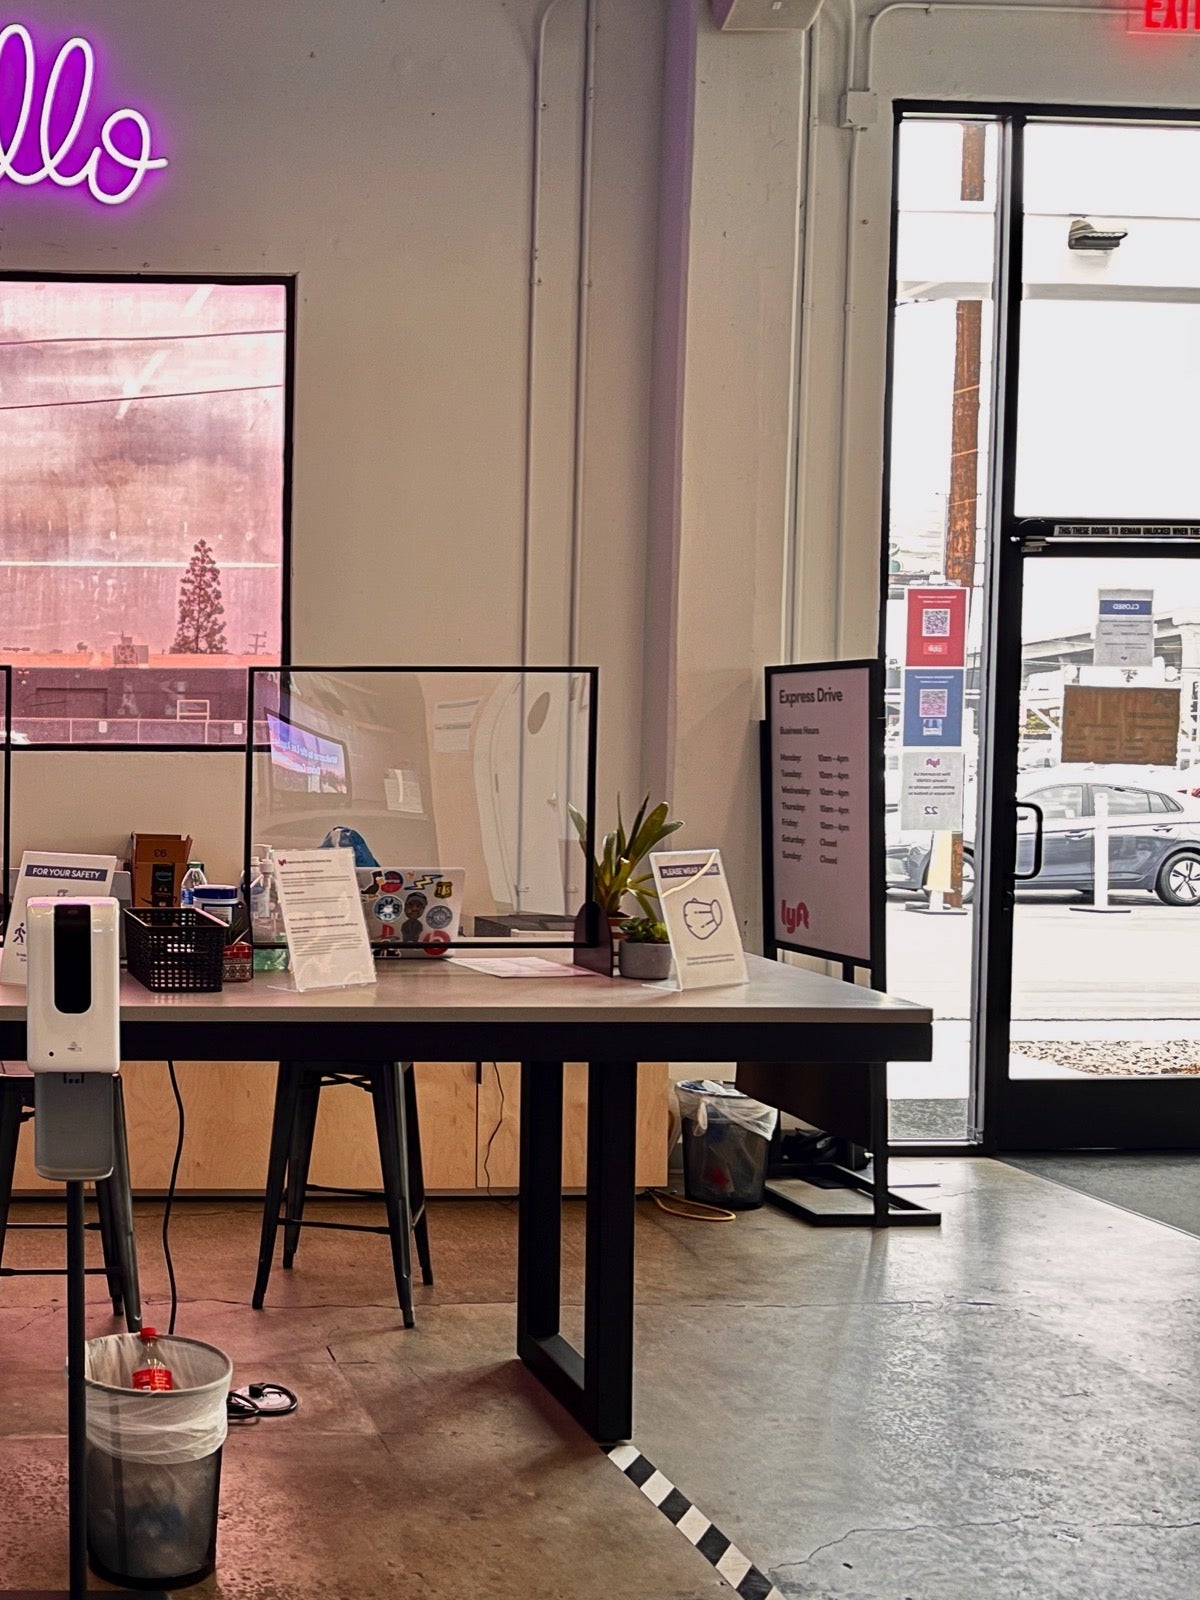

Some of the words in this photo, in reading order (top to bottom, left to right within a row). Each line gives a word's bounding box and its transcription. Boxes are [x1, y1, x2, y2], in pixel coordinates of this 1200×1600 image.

[1111, 527, 1119, 535] TO
[1120, 527, 1141, 535] REMAIN
[1143, 527, 1171, 535] UNLOCKED
[1172, 527, 1189, 535] WHEN
[779, 689, 815, 708] Express
[817, 686, 843, 702] Drive
[780, 726, 802, 735] Business
[32, 867, 49, 875] FOR
[49, 868, 70, 877] YOUR
[71, 869, 100, 879] SAFETY
[662, 868, 683, 876] PLEASE
[781, 899, 809, 934] lyft
